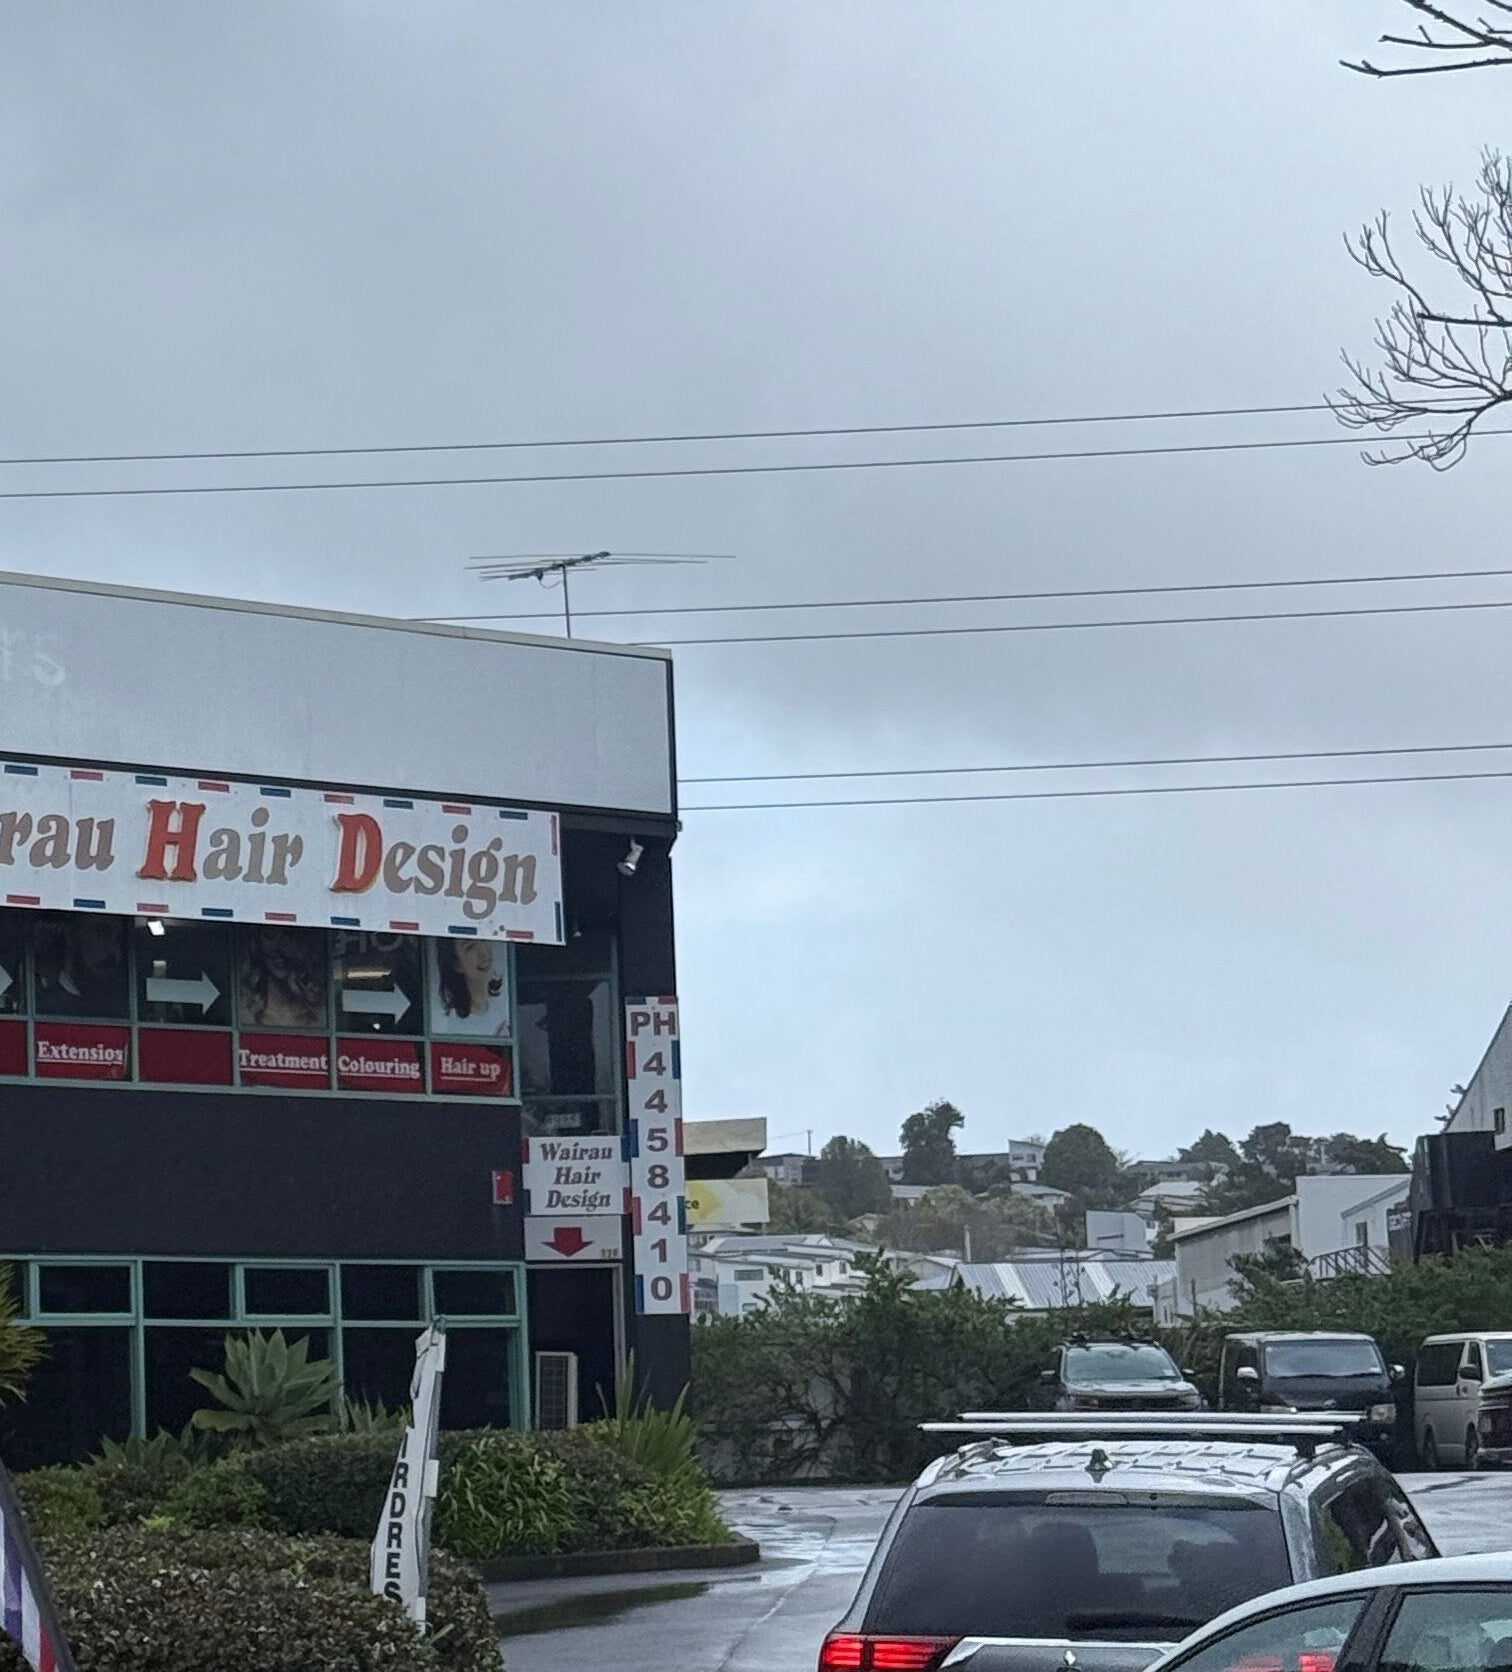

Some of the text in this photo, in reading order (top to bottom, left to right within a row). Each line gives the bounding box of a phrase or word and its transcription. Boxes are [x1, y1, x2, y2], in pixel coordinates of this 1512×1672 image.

[135, 799, 304, 886] Hair
[329, 812, 538, 920] Design
[630, 1011, 676, 1037] PH
[239, 1049, 328, 1070] Treatment
[338, 1055, 420, 1080] Colouring
[440, 1057, 501, 1081] Hair up
[539, 1142, 613, 1162] Wairau
[553, 1165, 601, 1185] Hair
[545, 1189, 611, 1212] Design
